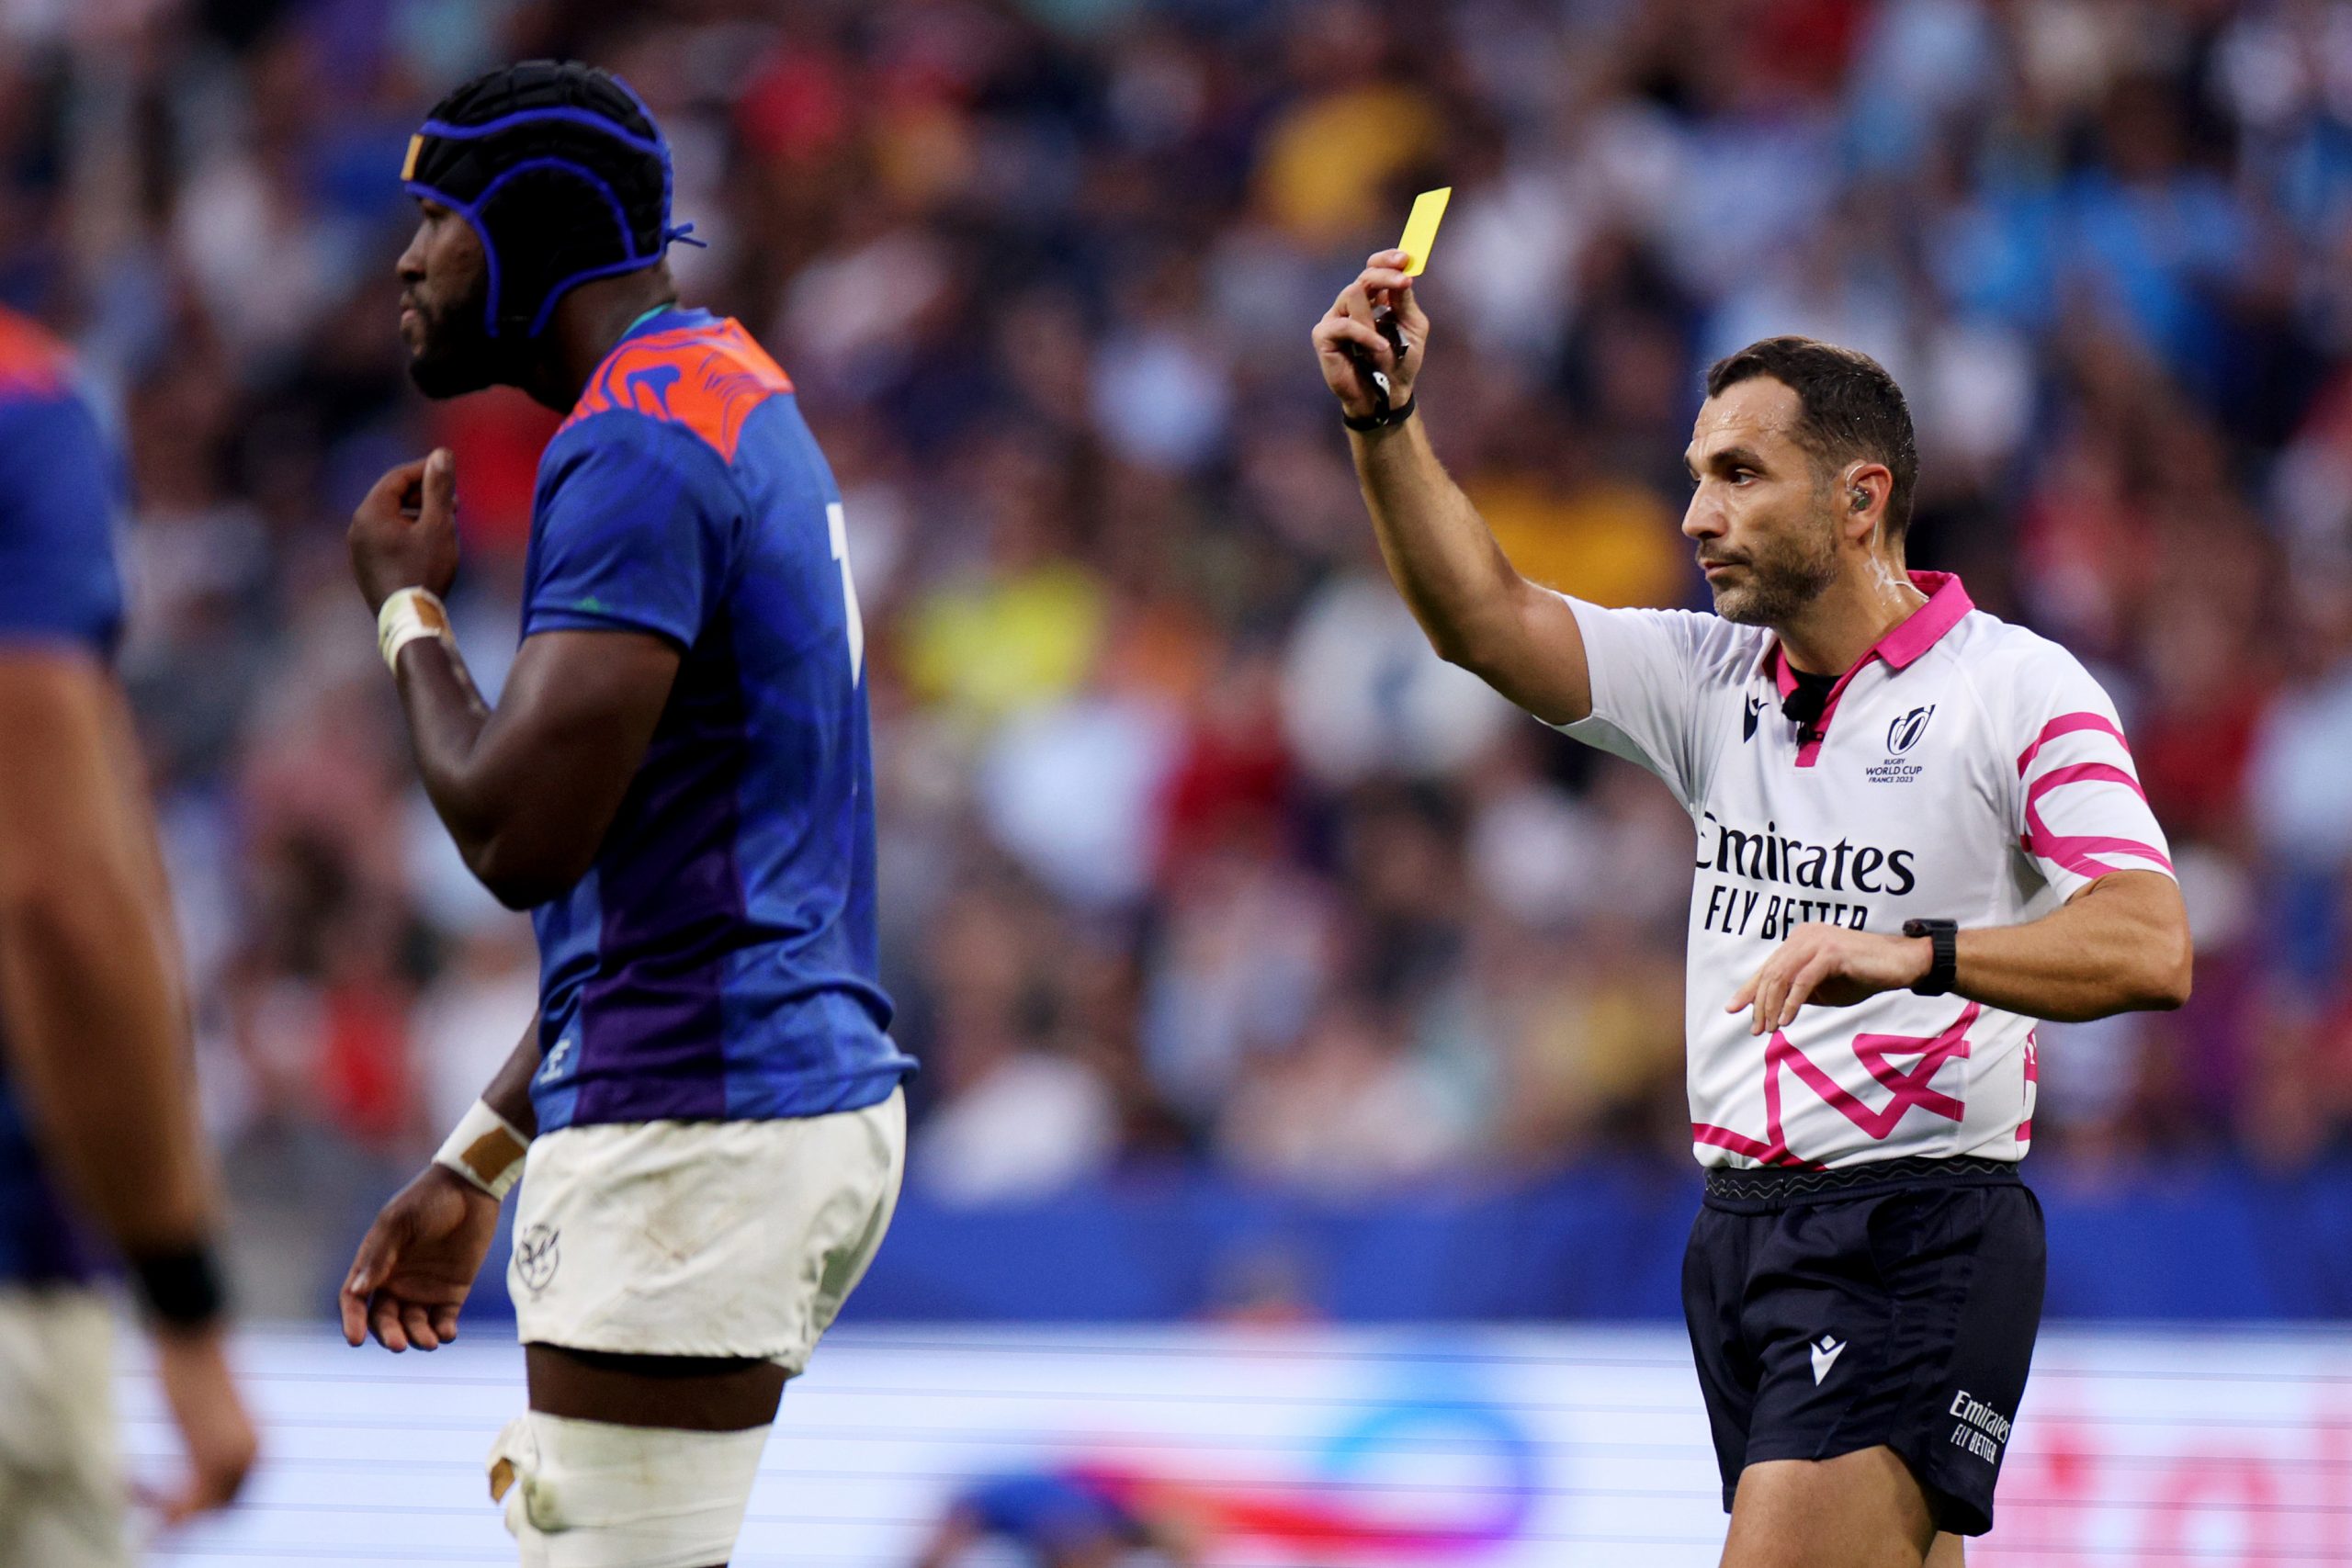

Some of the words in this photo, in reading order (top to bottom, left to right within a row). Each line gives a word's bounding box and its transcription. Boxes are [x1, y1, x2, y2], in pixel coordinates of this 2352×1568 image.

[1866, 766, 1901, 775] WORLD
[1902, 765, 1923, 775] CUP
[1704, 886, 1759, 935] FLY
[1949, 1389, 2011, 1444] Emirates
[1950, 1423, 1973, 1448] FLY
[1968, 1431, 1997, 1465] BETTER
